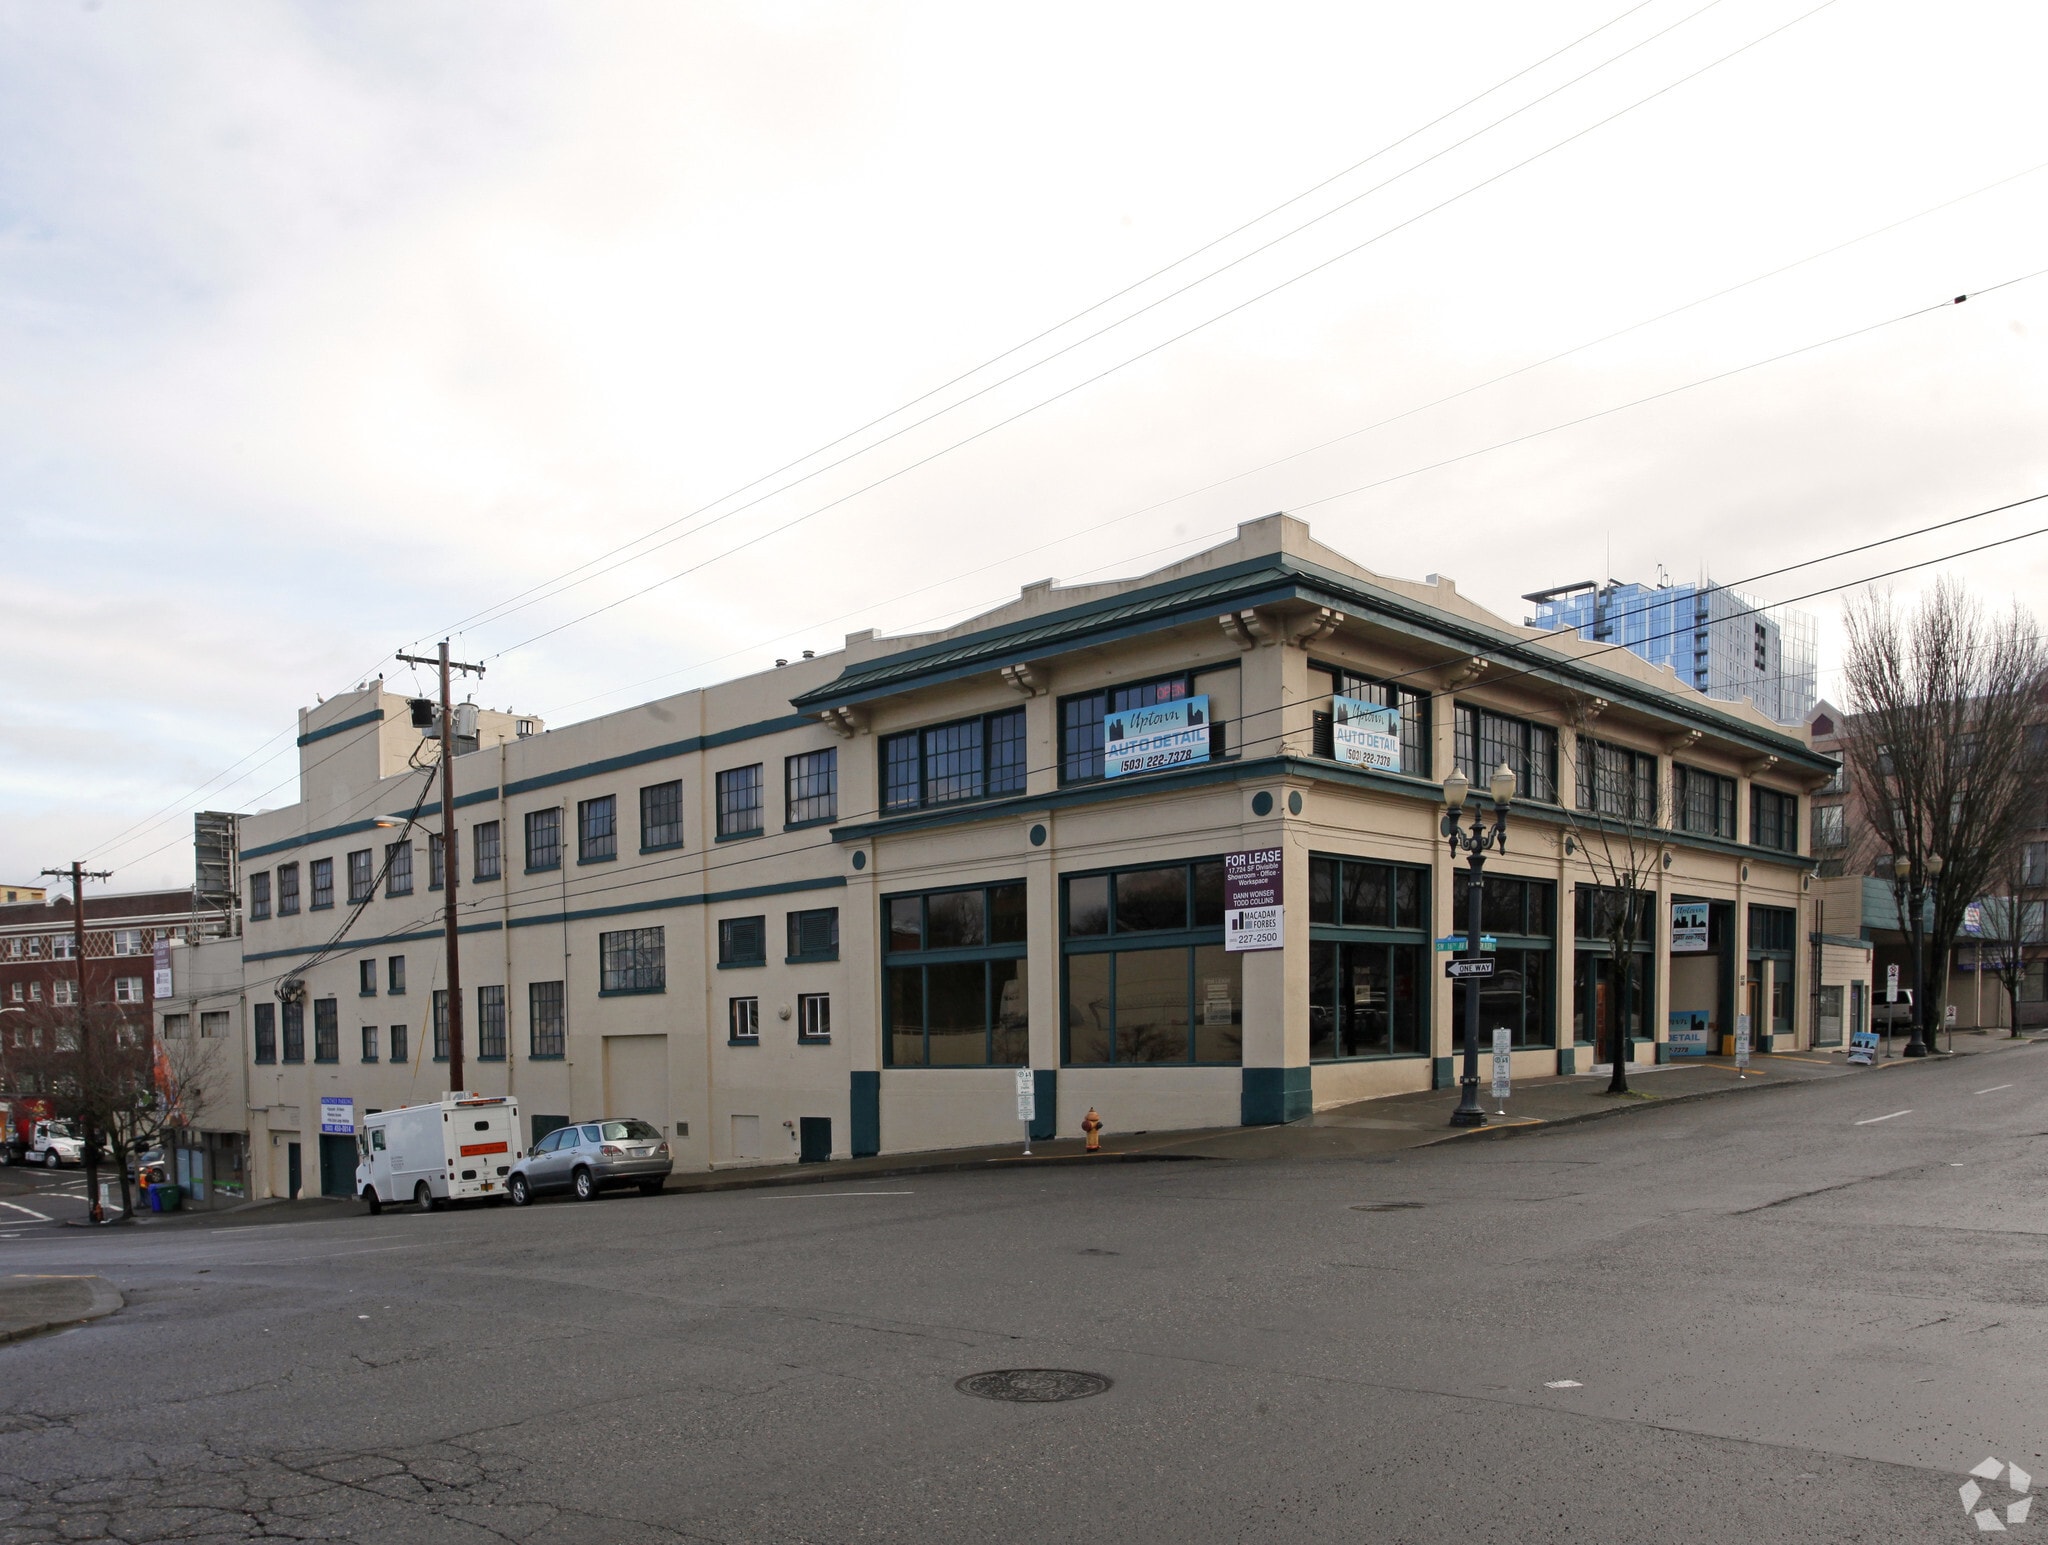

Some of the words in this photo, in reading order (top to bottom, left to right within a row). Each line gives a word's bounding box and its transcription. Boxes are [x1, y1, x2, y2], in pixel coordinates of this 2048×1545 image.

[1157, 683, 1185, 699] OPEN
[1352, 703, 1385, 726] Uptown
[1130, 711, 1180, 733] Uptown
[1108, 738, 1150, 757] AUTO
[1153, 730, 1205, 750] DETAIL
[1337, 728, 1364, 745] AUTO
[1367, 733, 1398, 752] DETAIL
[1120, 757, 1144, 772] (503)
[1146, 749, 1192, 768] 222-7378
[1345, 747, 1361, 762] (503)
[1363, 752, 1391, 767] 222-7378
[1225, 854, 1246, 867] FOR
[1248, 850, 1281, 864] LEASE
[1227, 872, 1256, 881] Showroom
[1238, 877, 1268, 887] Workspace
[1249, 889, 1275, 898] WONSER
[1250, 897, 1274, 905] COLLINS
[1244, 910, 1276, 919] MACADAM
[1253, 919, 1276, 929] FORBES
[1238, 932, 1277, 944] 227-2500
[1460, 964, 1472, 972] ONE
[1475, 963, 1490, 972] WAY
